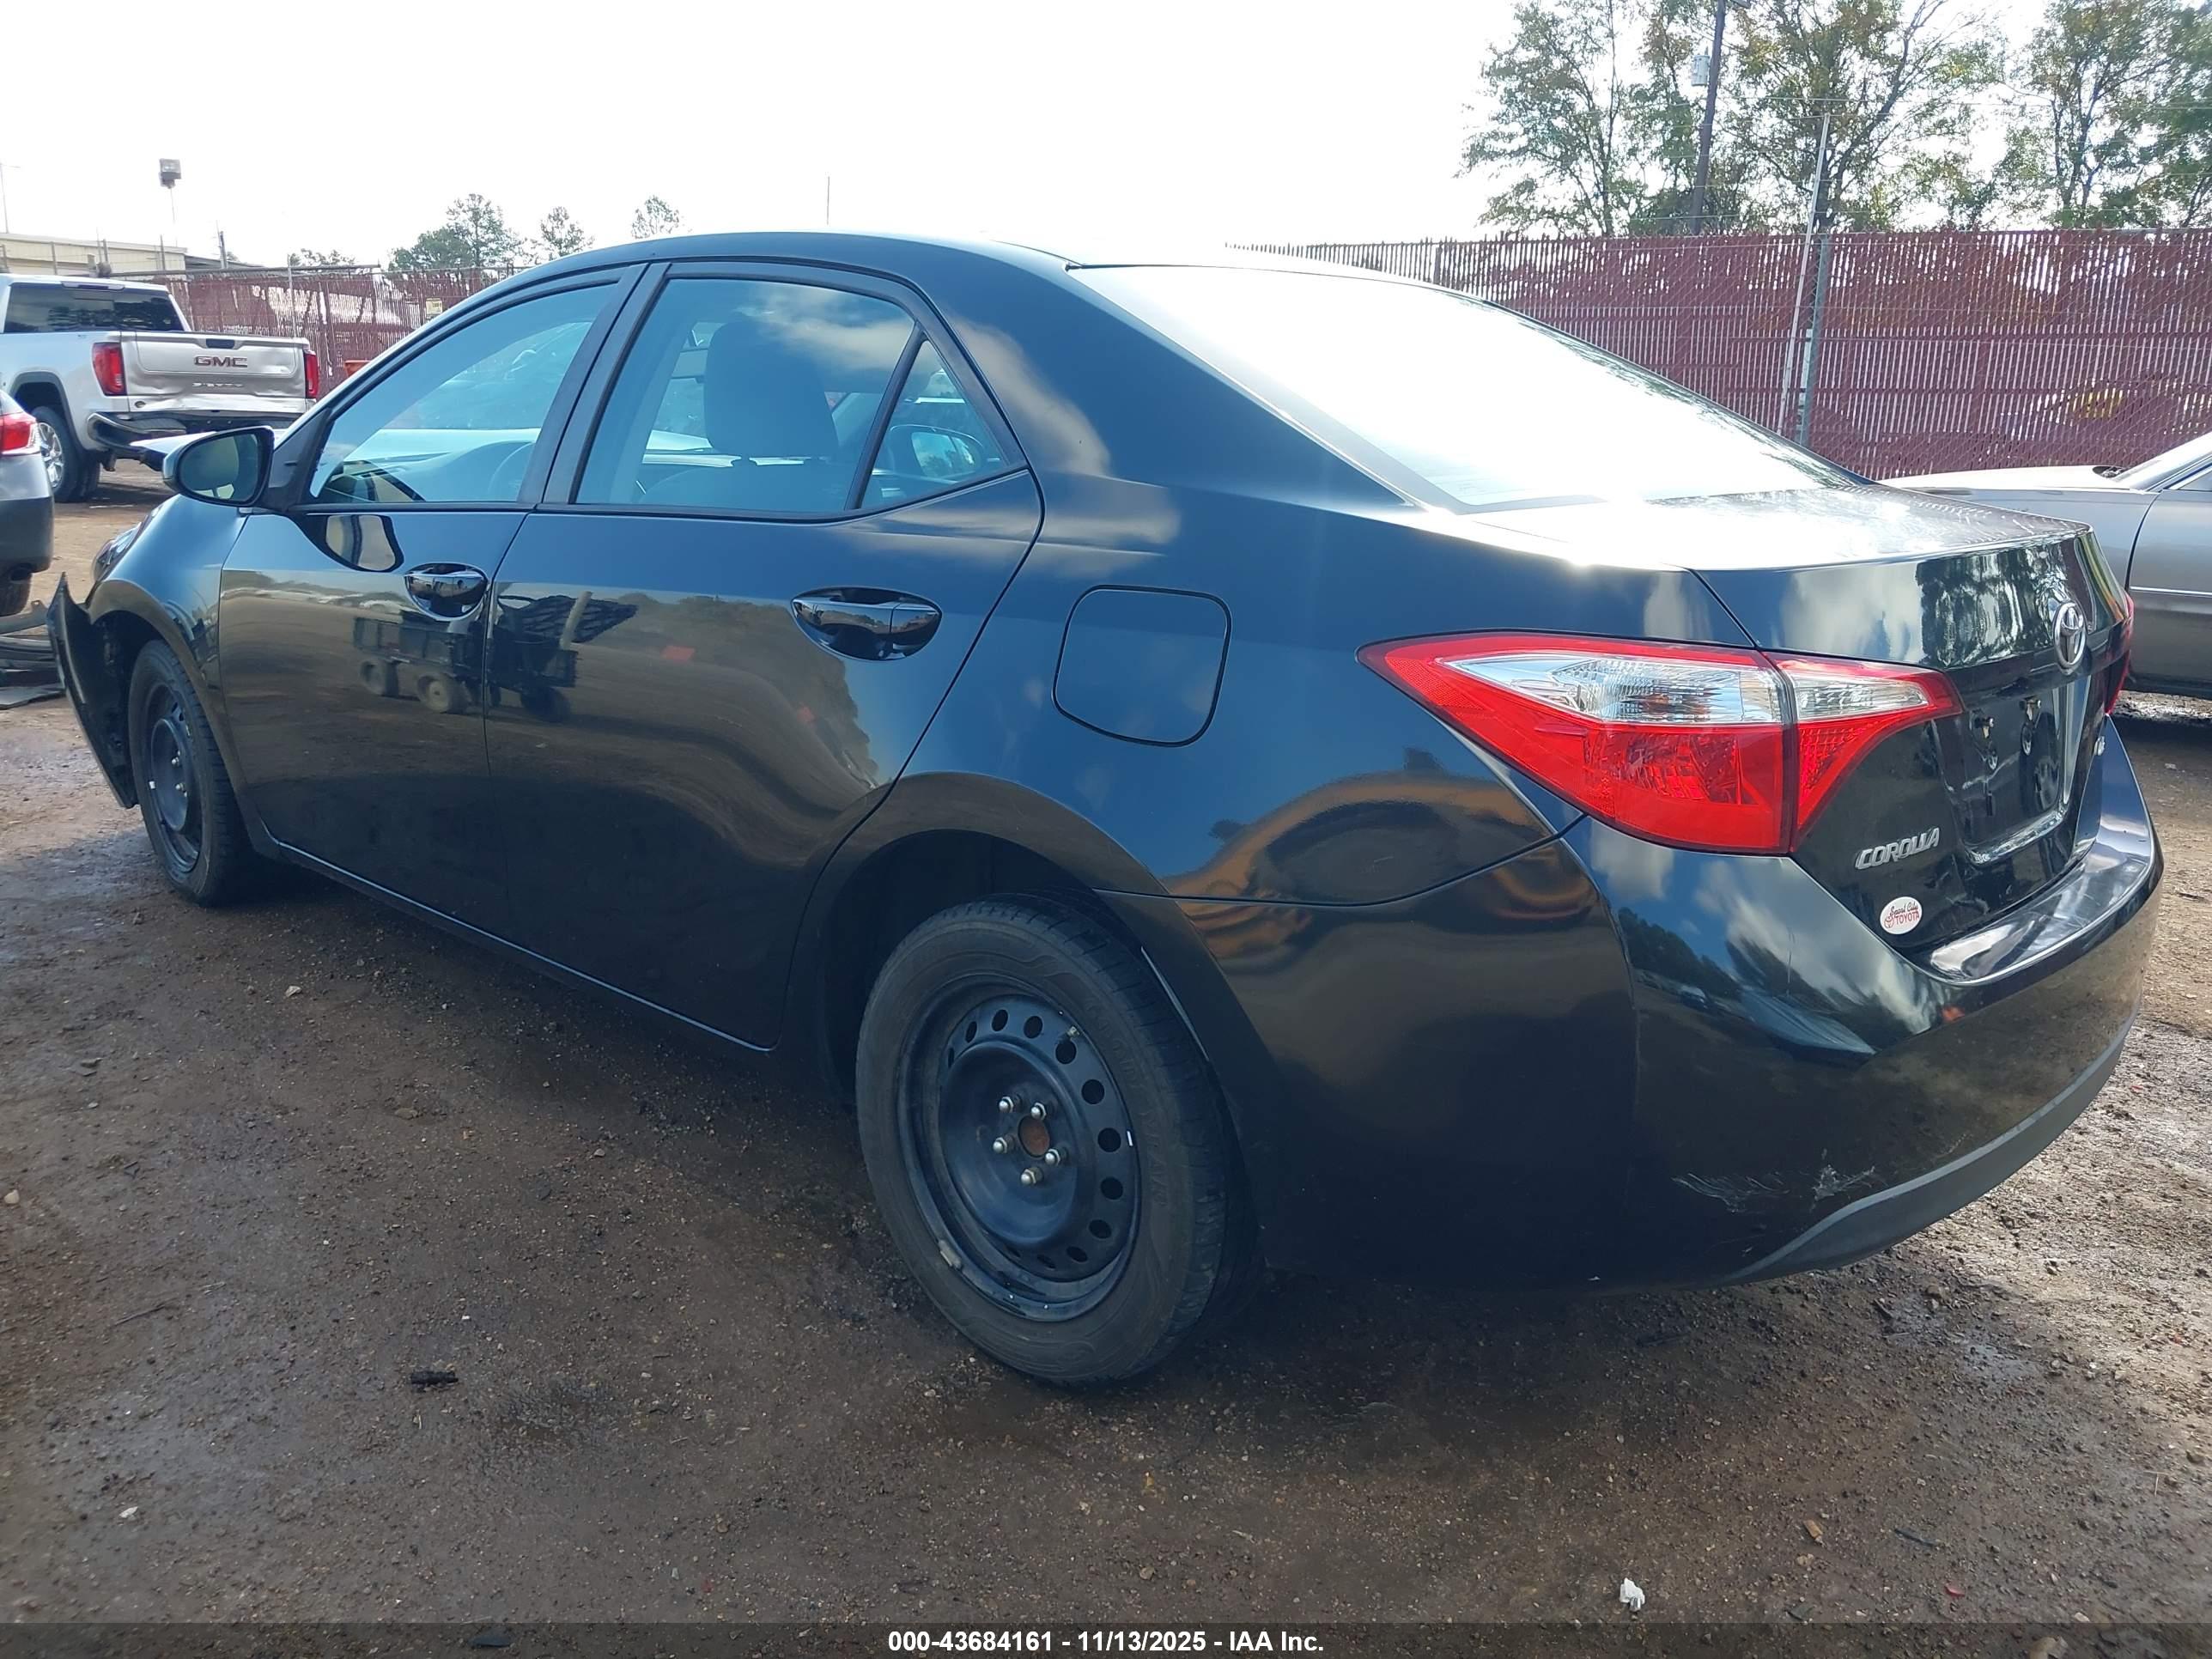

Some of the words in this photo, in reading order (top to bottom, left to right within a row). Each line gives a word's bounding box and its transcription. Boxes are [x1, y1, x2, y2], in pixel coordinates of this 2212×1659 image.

[194, 356, 248, 368] GMC
[1855, 827, 1940, 870] COROLLA
[1894, 910, 1920, 926] TOYOTA
